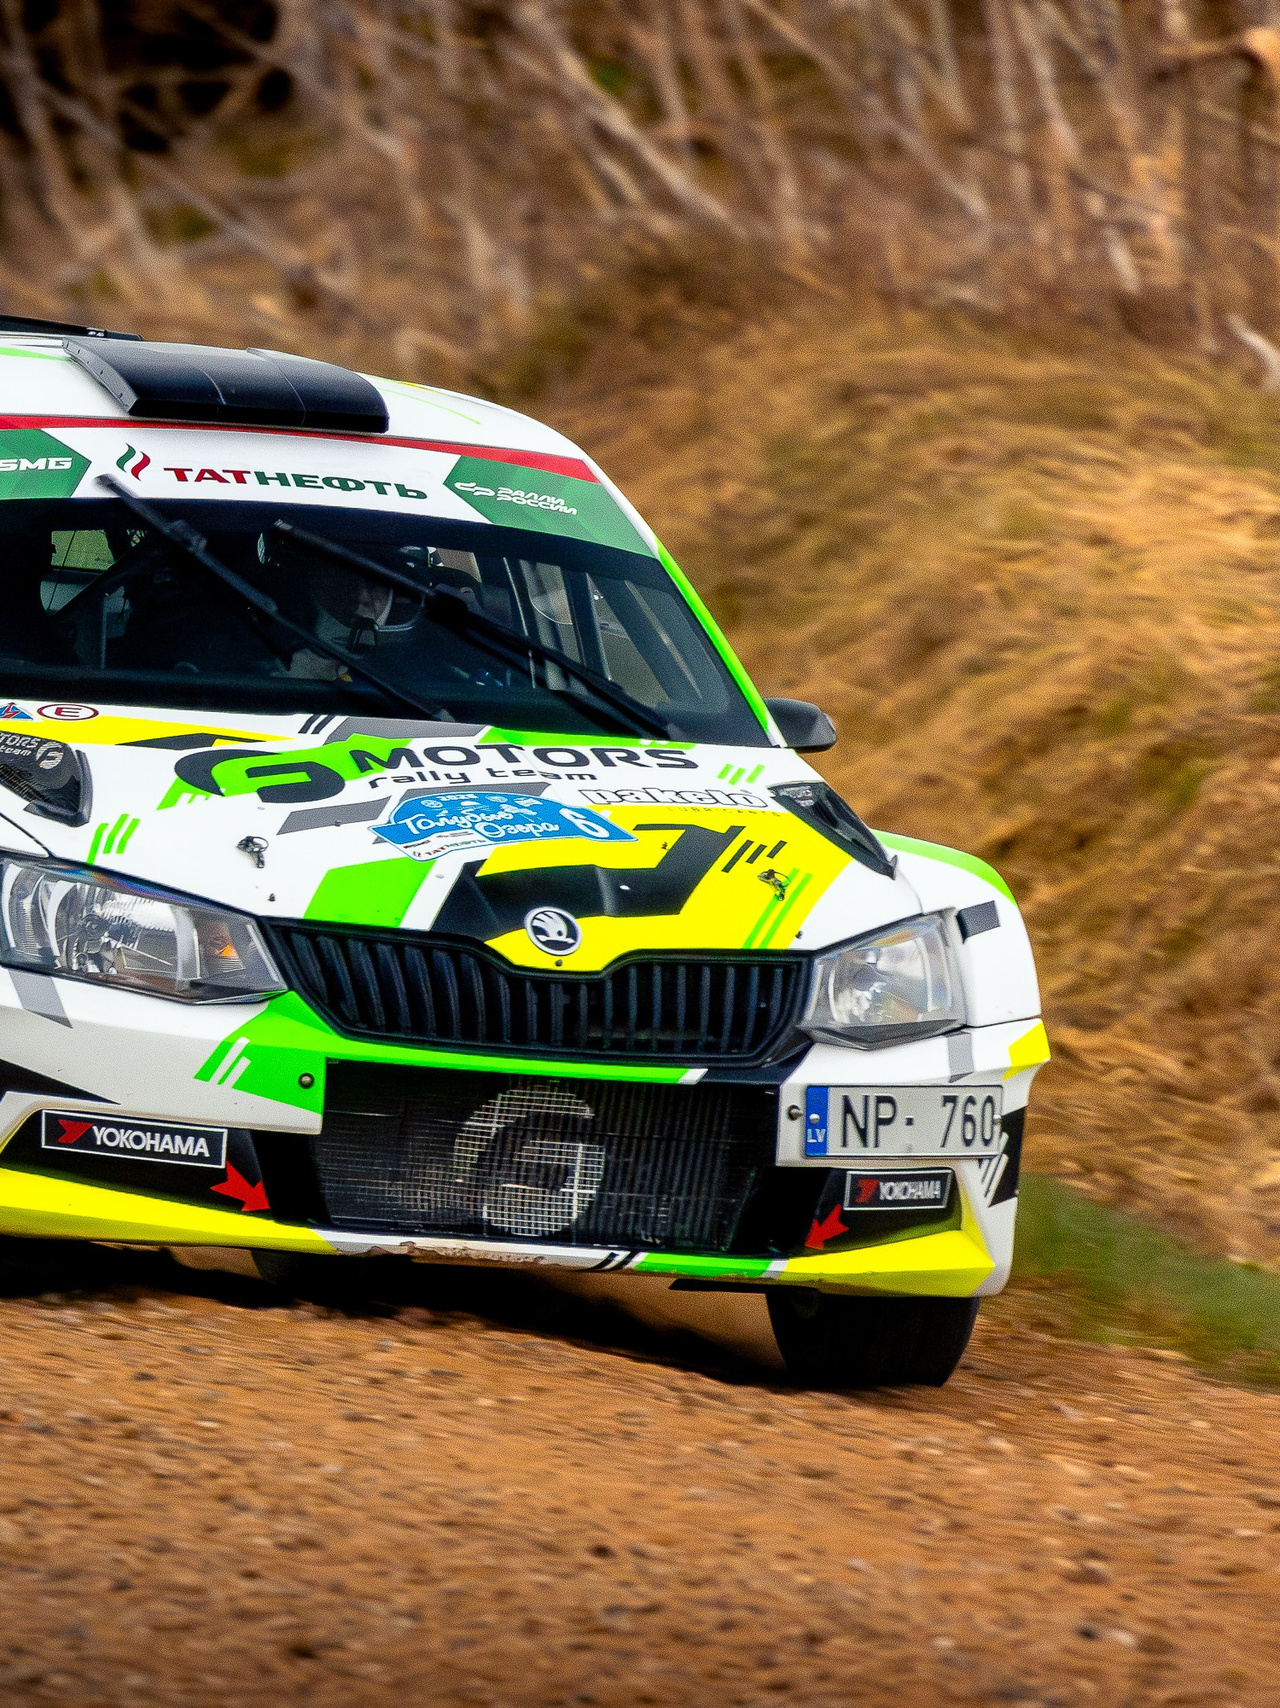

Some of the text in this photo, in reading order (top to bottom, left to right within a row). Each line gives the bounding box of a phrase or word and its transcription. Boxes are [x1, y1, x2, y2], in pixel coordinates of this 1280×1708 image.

[163, 467, 428, 500] ТАТНЕФТЬ
[349, 743, 699, 774] MOTORS
[368, 767, 598, 789] rally team
[559, 807, 610, 839] 6
[92, 1125, 210, 1158] YOKOHAMA
[806, 1128, 827, 1143] LV
[879, 1180, 941, 1201] YOKOHAMA
